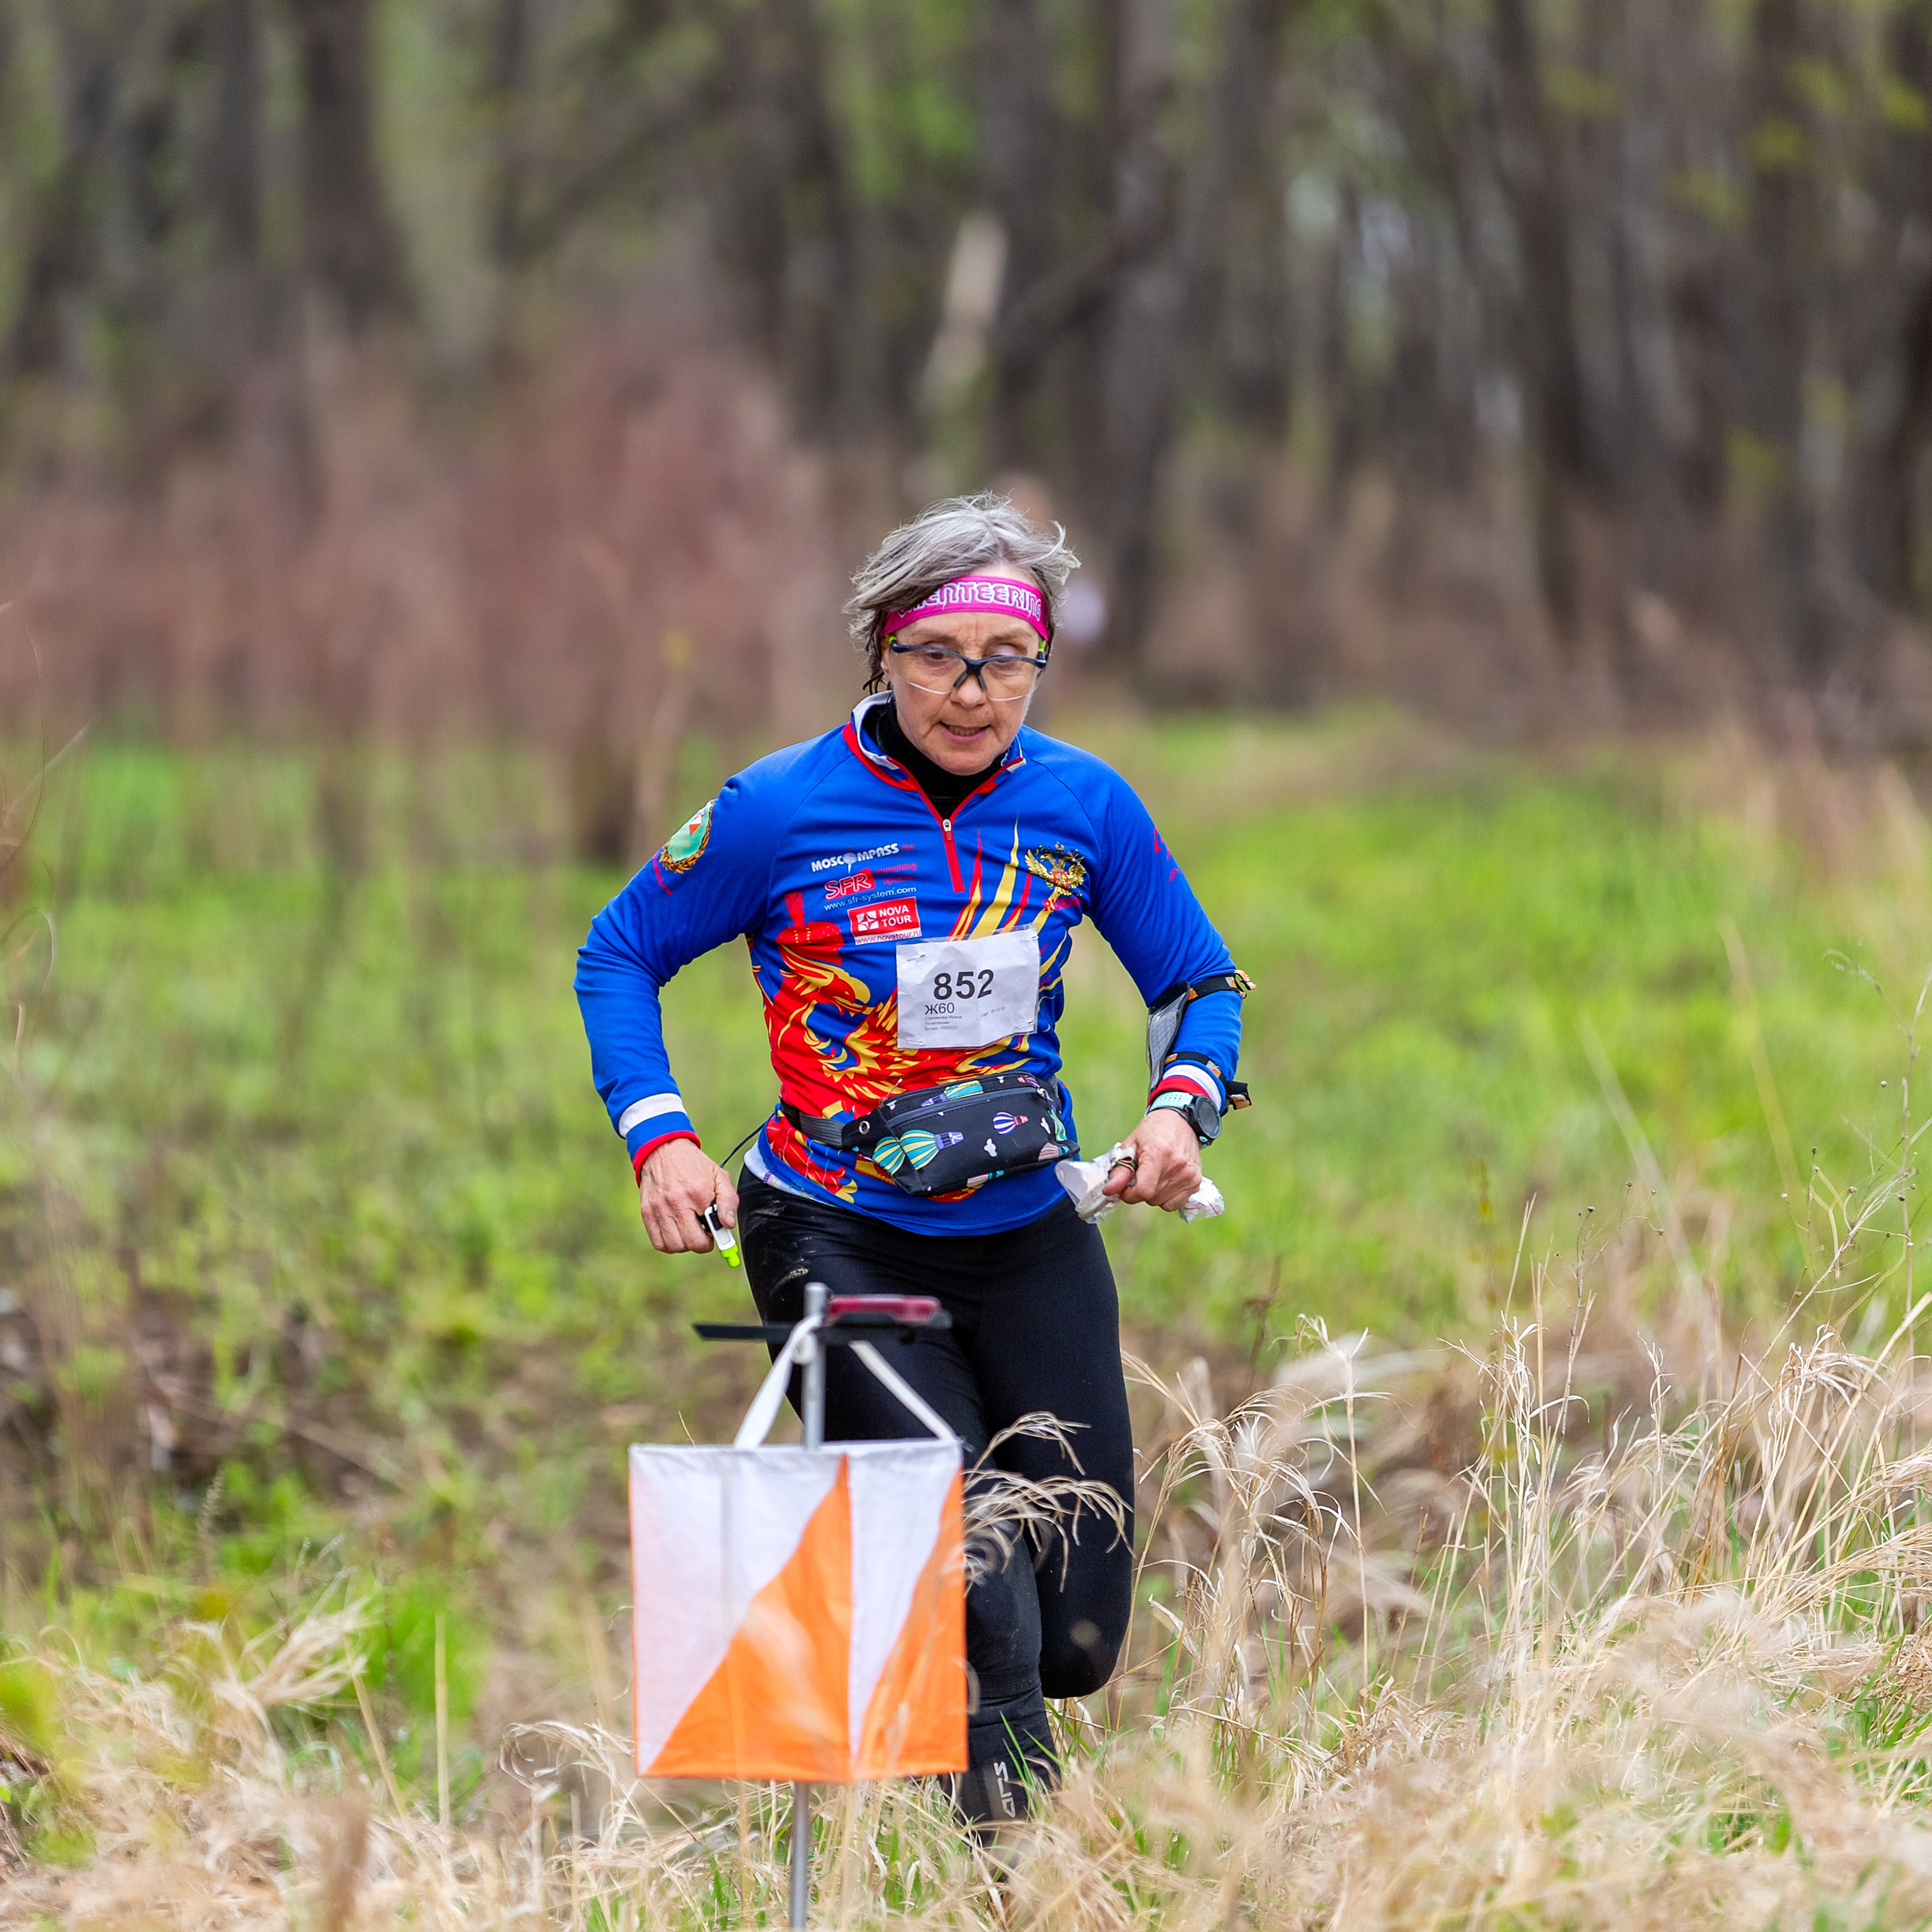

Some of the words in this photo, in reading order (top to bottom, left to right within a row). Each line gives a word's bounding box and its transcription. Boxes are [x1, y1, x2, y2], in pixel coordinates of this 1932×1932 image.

[875, 863, 917, 875] punching
[825, 873, 871, 900] SFR
[883, 875, 914, 885] system
[824, 887, 916, 911] www.sfr-system.com
[879, 905, 909, 917] NOVA
[881, 915, 912, 928] TOUR
[855, 930, 921, 944] www.novatour.ru
[934, 969, 994, 1000] 852
[924, 1002, 955, 1015] Ж60
